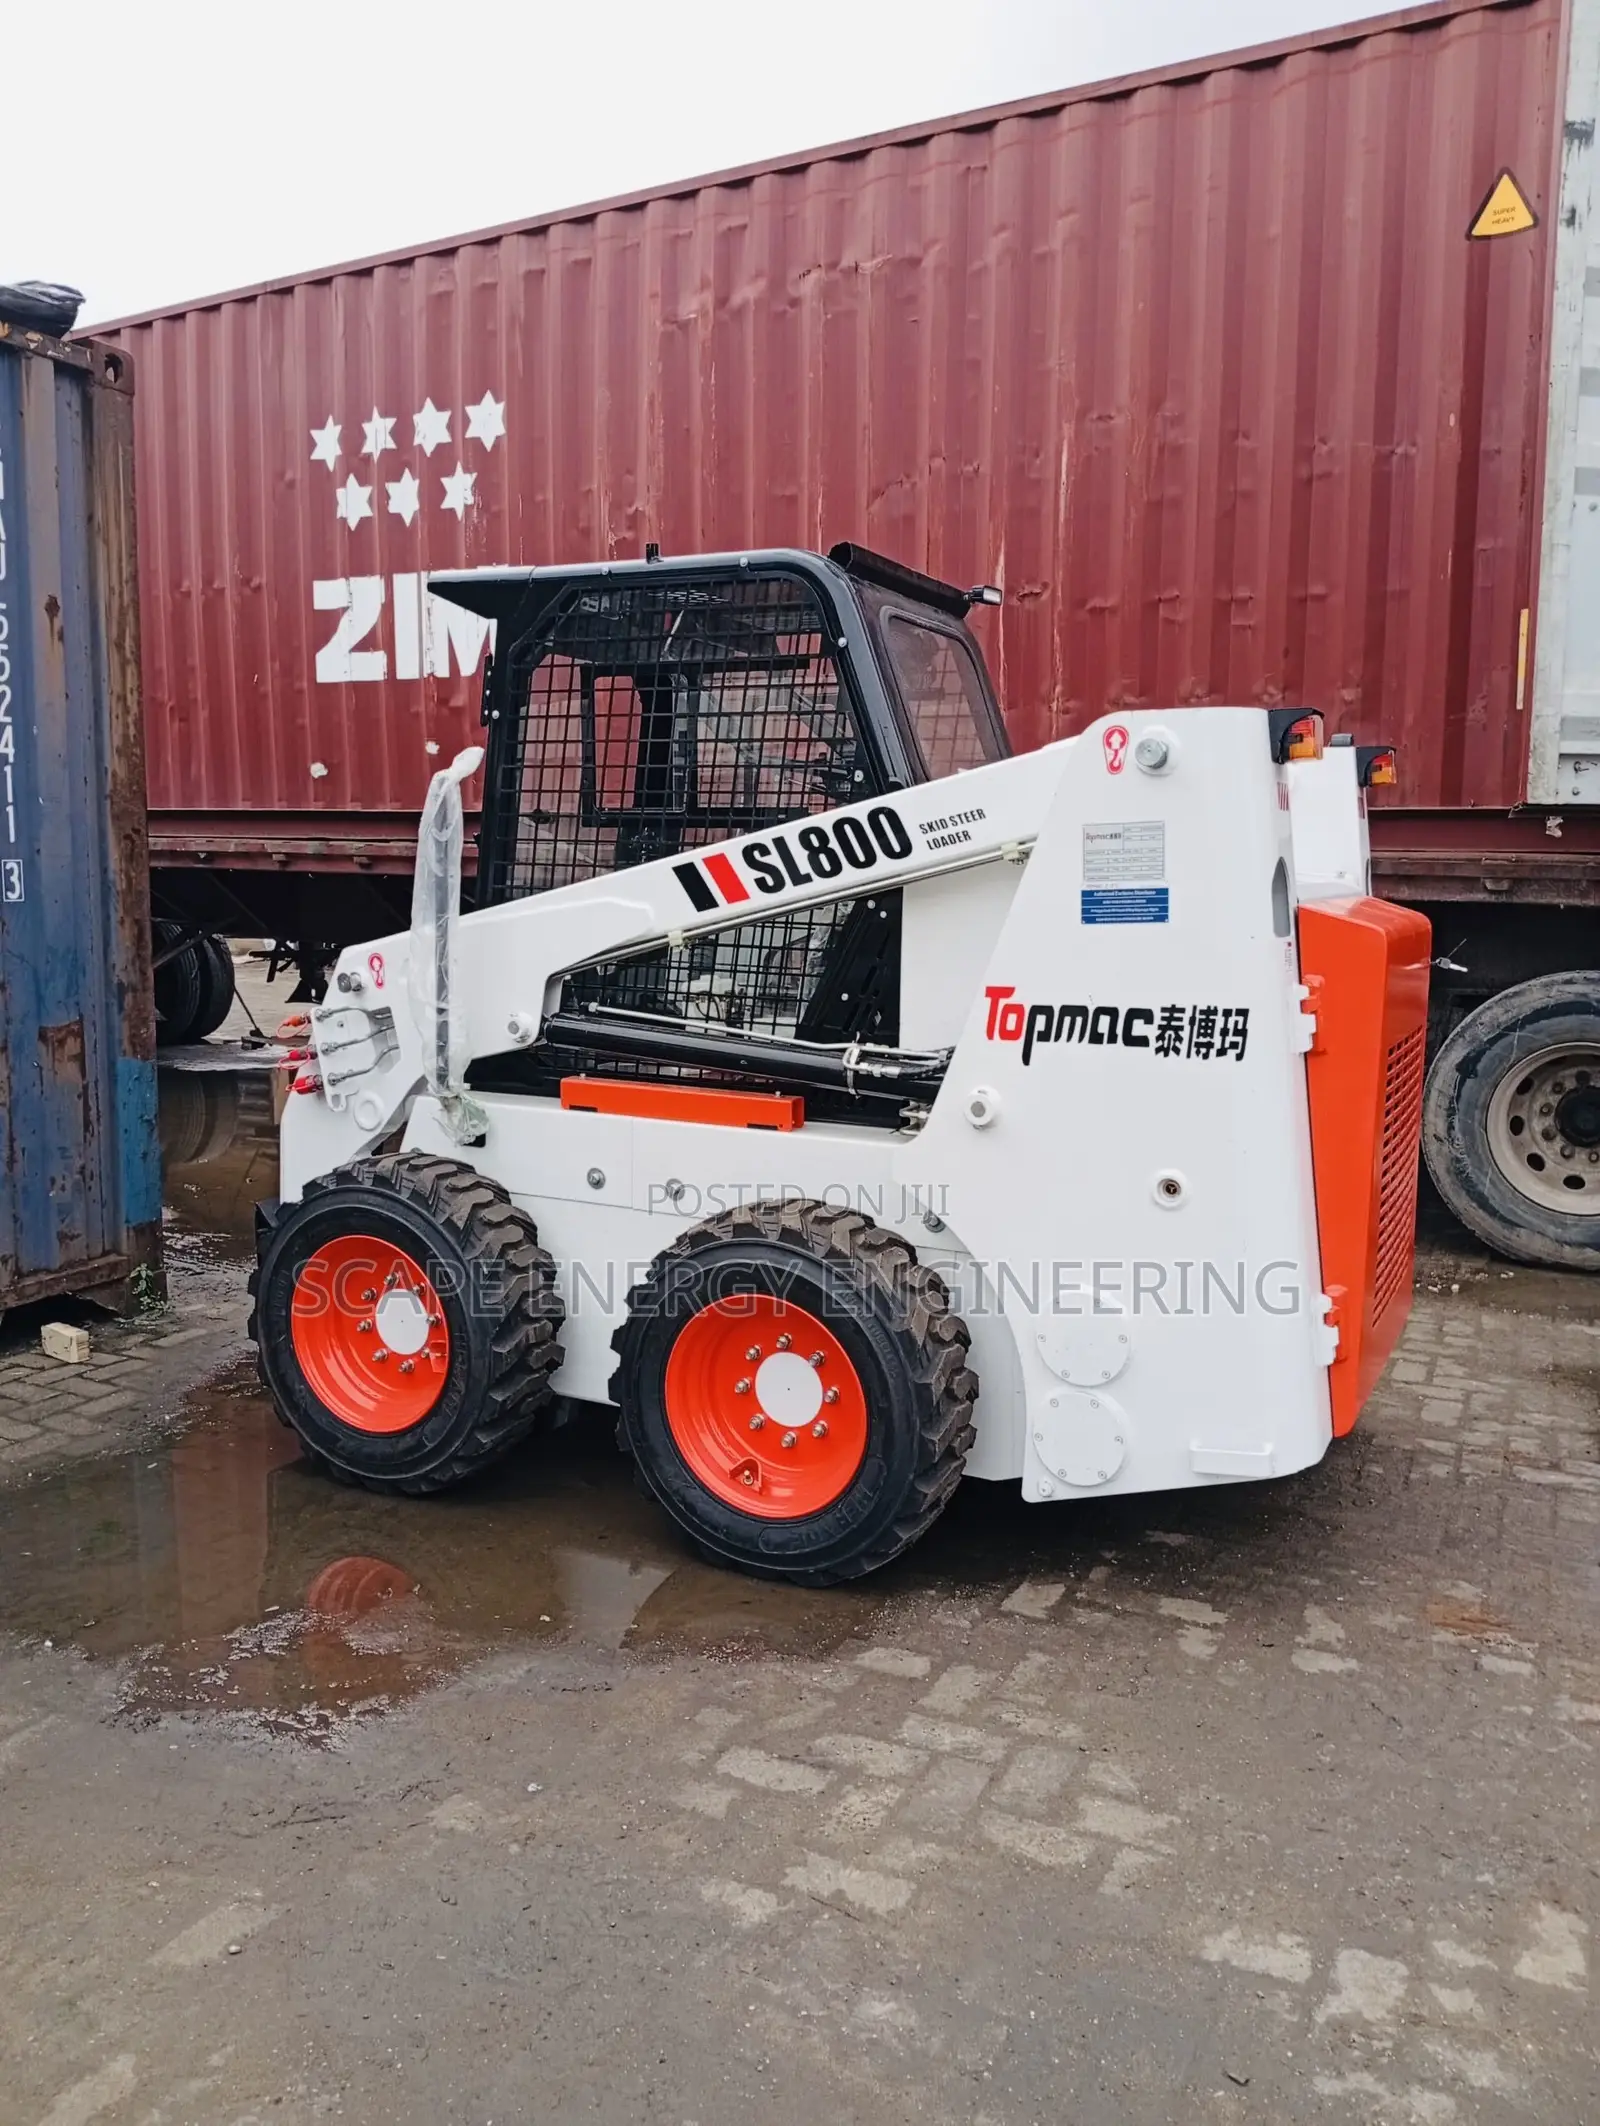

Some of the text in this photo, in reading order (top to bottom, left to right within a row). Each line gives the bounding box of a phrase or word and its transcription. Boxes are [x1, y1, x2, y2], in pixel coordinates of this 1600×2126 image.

[1491, 216, 1515, 224] HEAVY
[1492, 206, 1516, 215] SUPER
[312, 571, 498, 683] ZIM
[918, 808, 987, 836] SKID STEER
[926, 830, 972, 850] LOADER
[741, 806, 913, 894] SL800
[5, 862, 20, 900] 3
[985, 986, 1154, 1066] Topmac
[1155, 1004, 1250, 1062] 泰博玛
